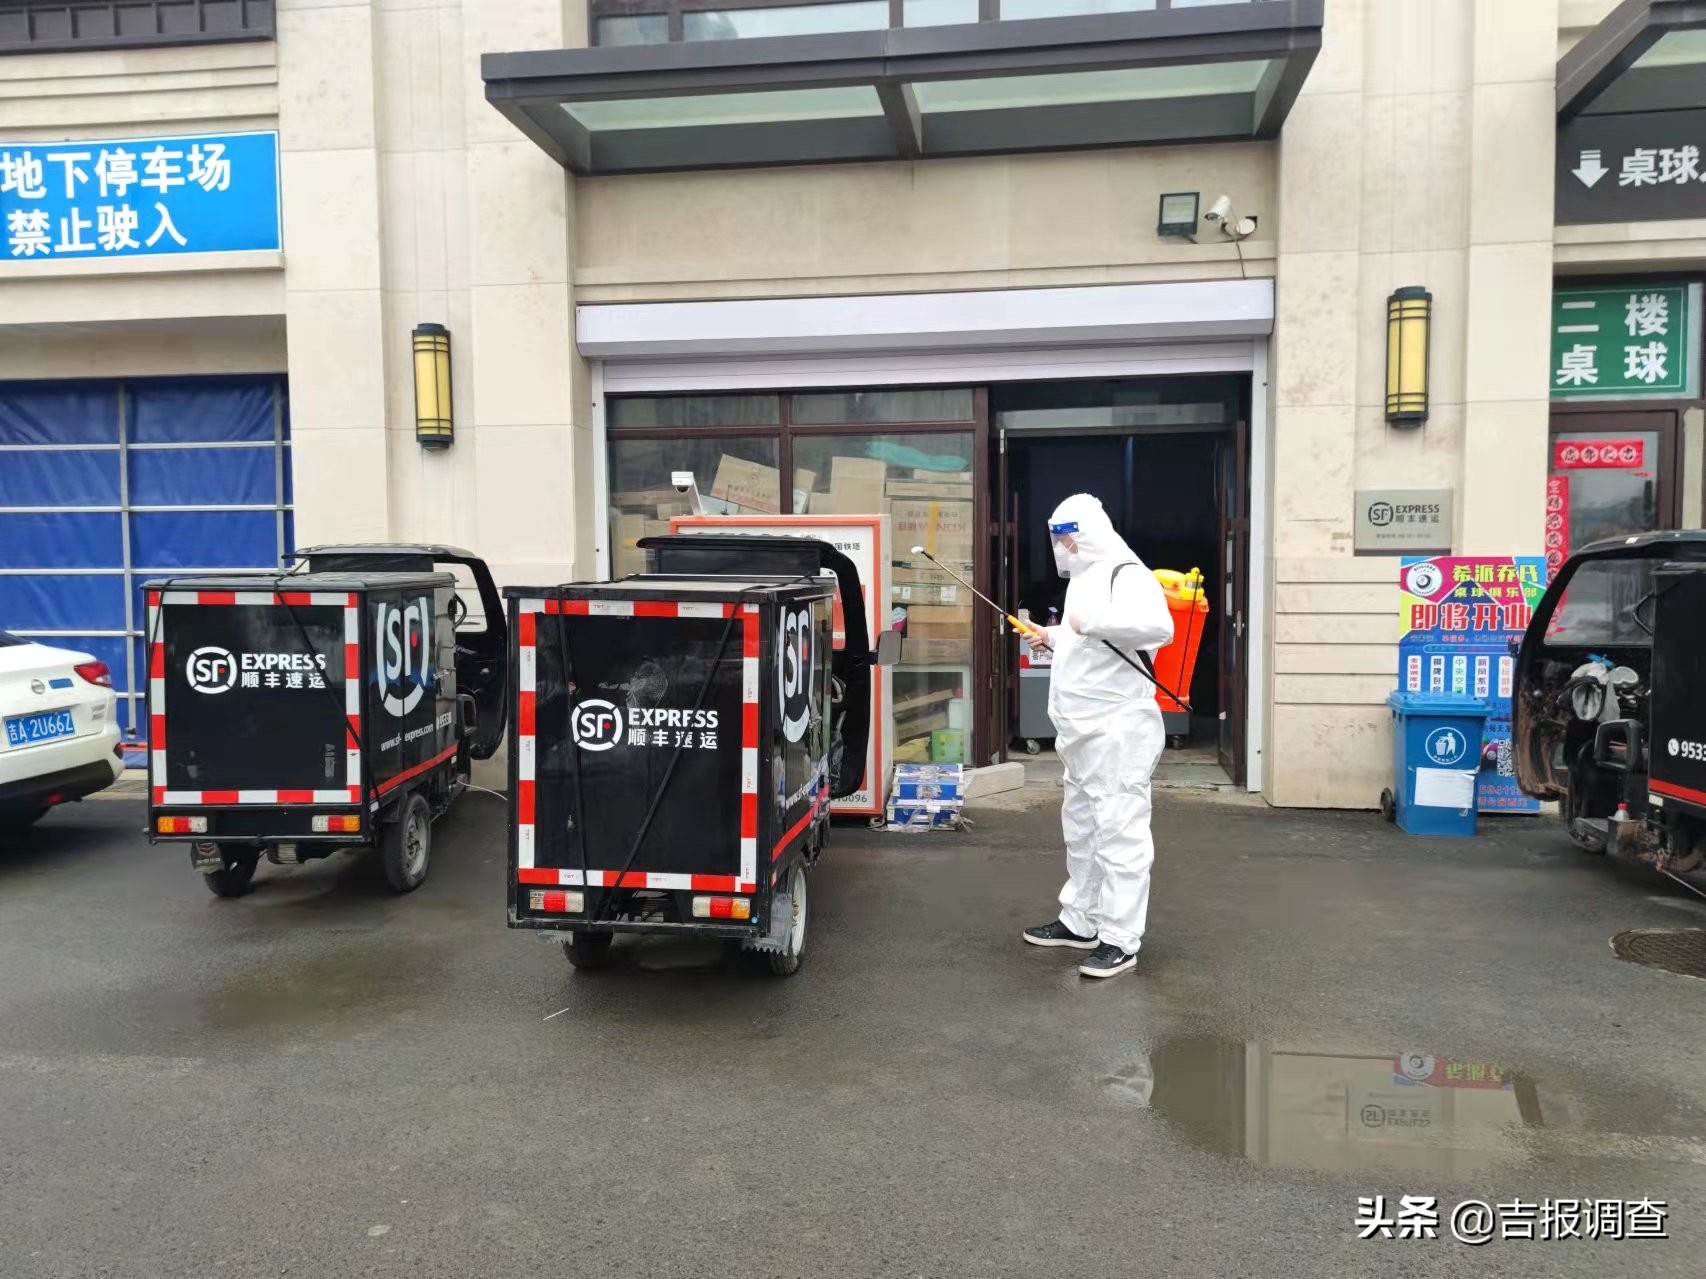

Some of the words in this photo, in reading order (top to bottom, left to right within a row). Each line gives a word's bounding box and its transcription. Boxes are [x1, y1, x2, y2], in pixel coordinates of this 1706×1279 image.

[0, 143, 231, 199] 地下停车场
[1619, 145, 1706, 187] 桌球
[8, 202, 187, 256] 禁止驶入
[1557, 293, 1669, 337] 二楼
[1556, 341, 1668, 386] 桌球
[1395, 504, 1440, 514] EXPRESS
[834, 542, 861, 551] 国铁塔
[1452, 564, 1539, 583] 希派乔氏
[1453, 587, 1538, 599] 桌球俱乐部
[1411, 602, 1534, 631] 即将开业
[241, 653, 326, 670] EXPRESS
[241, 671, 326, 689] 顺丰速运
[628, 707, 719, 729] EXPRESS
[628, 728, 719, 750] 顺丰速运
